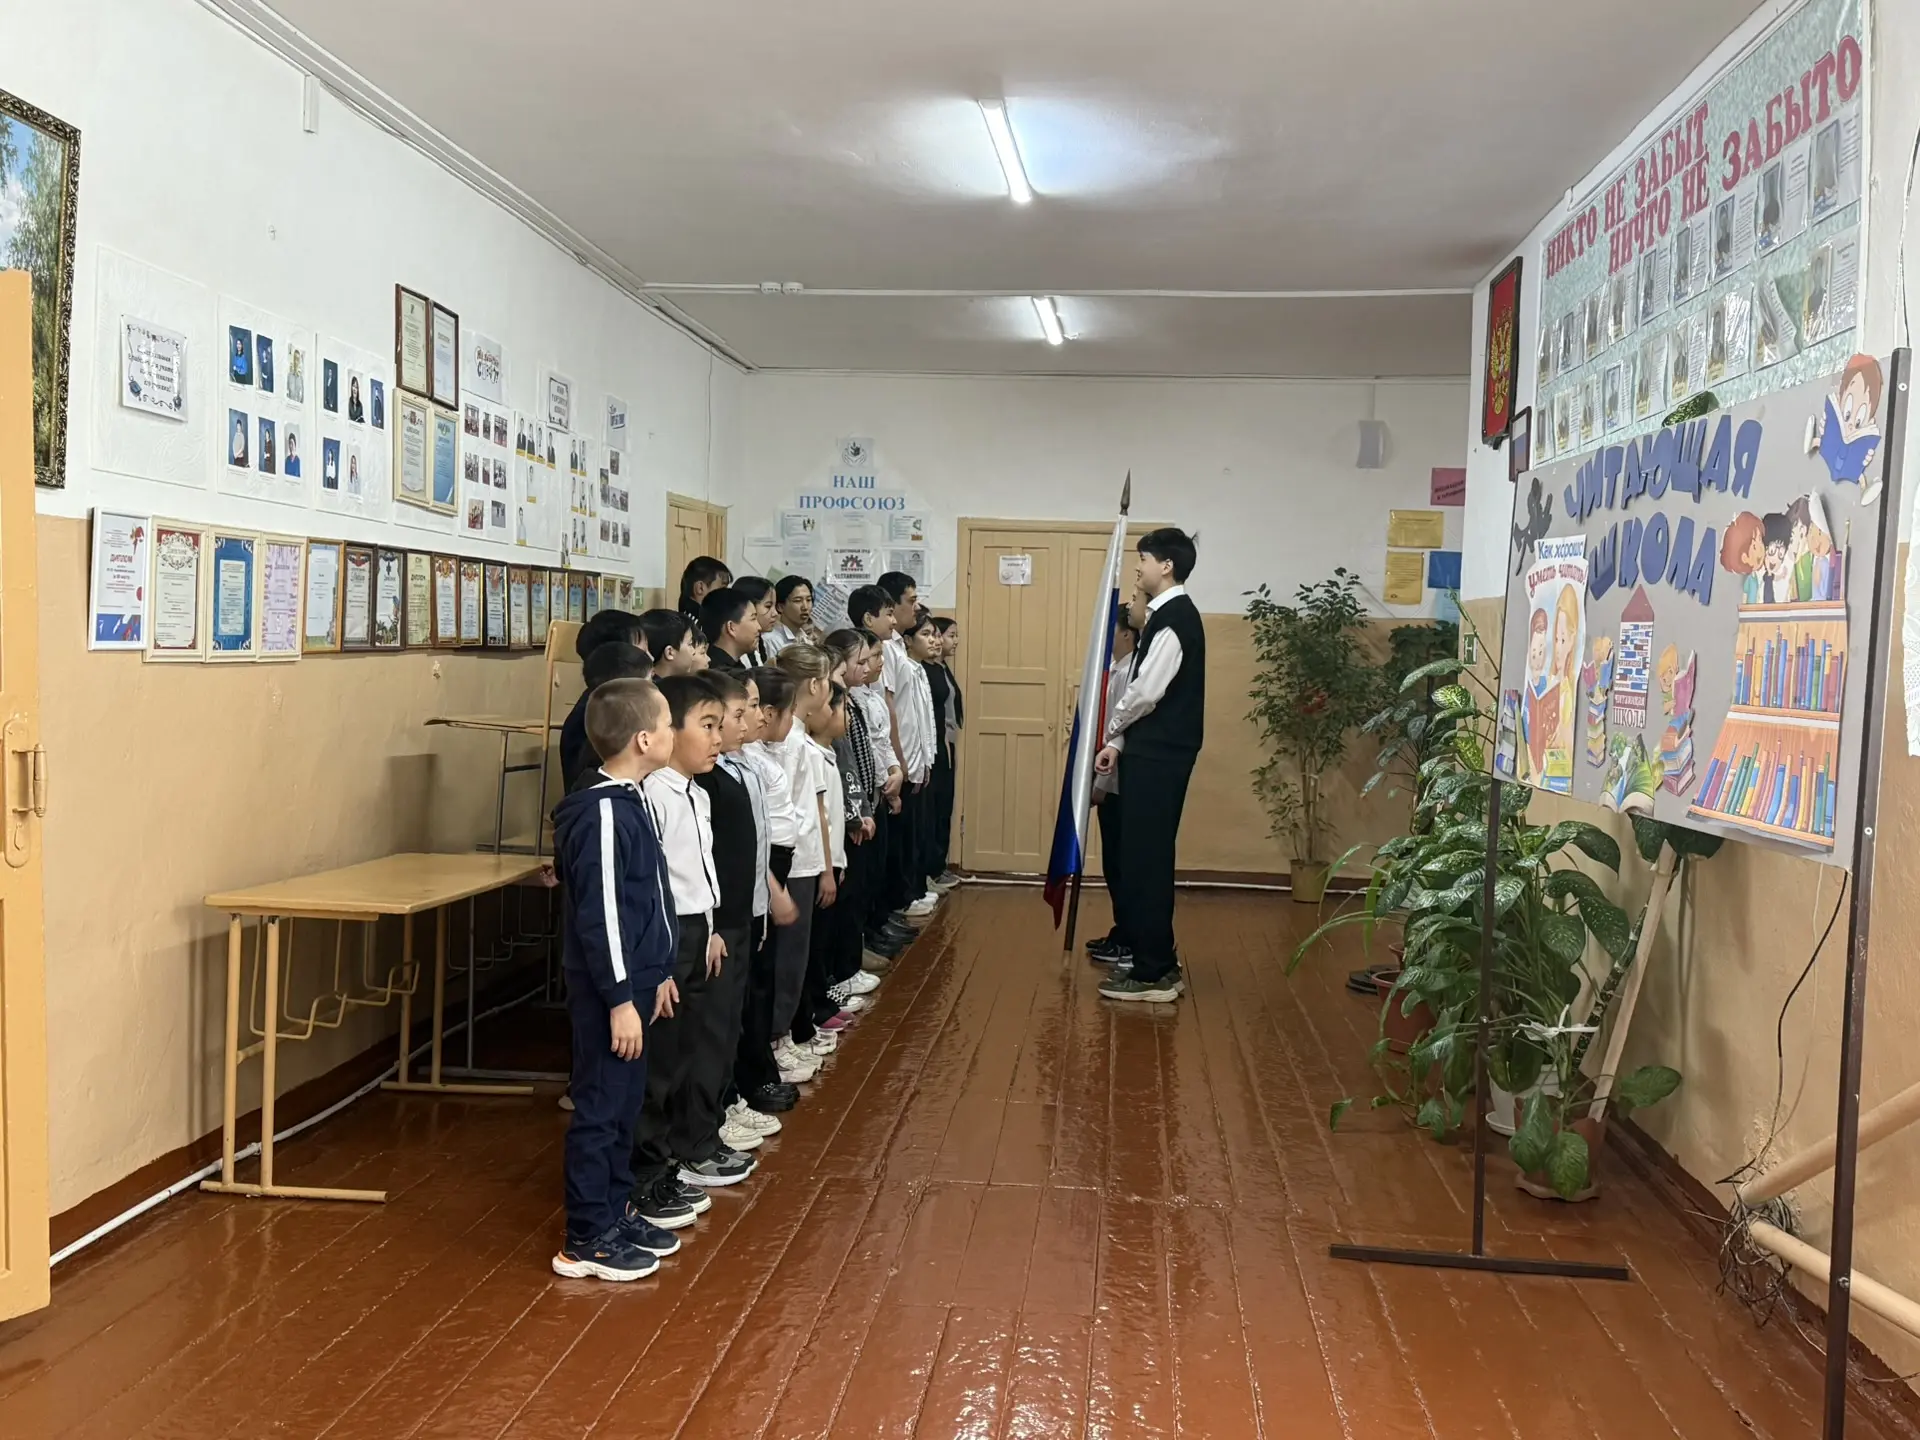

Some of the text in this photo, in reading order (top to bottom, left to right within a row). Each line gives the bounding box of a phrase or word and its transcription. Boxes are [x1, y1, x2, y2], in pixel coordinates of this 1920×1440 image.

[1608, 34, 1863, 277] НИЧТО НЕ ЗАБЫТО
[1547, 100, 1709, 280] НИКТО НЕ ЗАБЫТ
[833, 475, 875, 489] НАШ
[1563, 414, 1763, 523] ЧИТАЮЩАЯ
[799, 496, 905, 511] ПРОФСОЮЗ
[1538, 541, 1553, 559] Как
[1588, 511, 1717, 606] ШКОЛА
[1613, 707, 1646, 729] ШКОЛА
